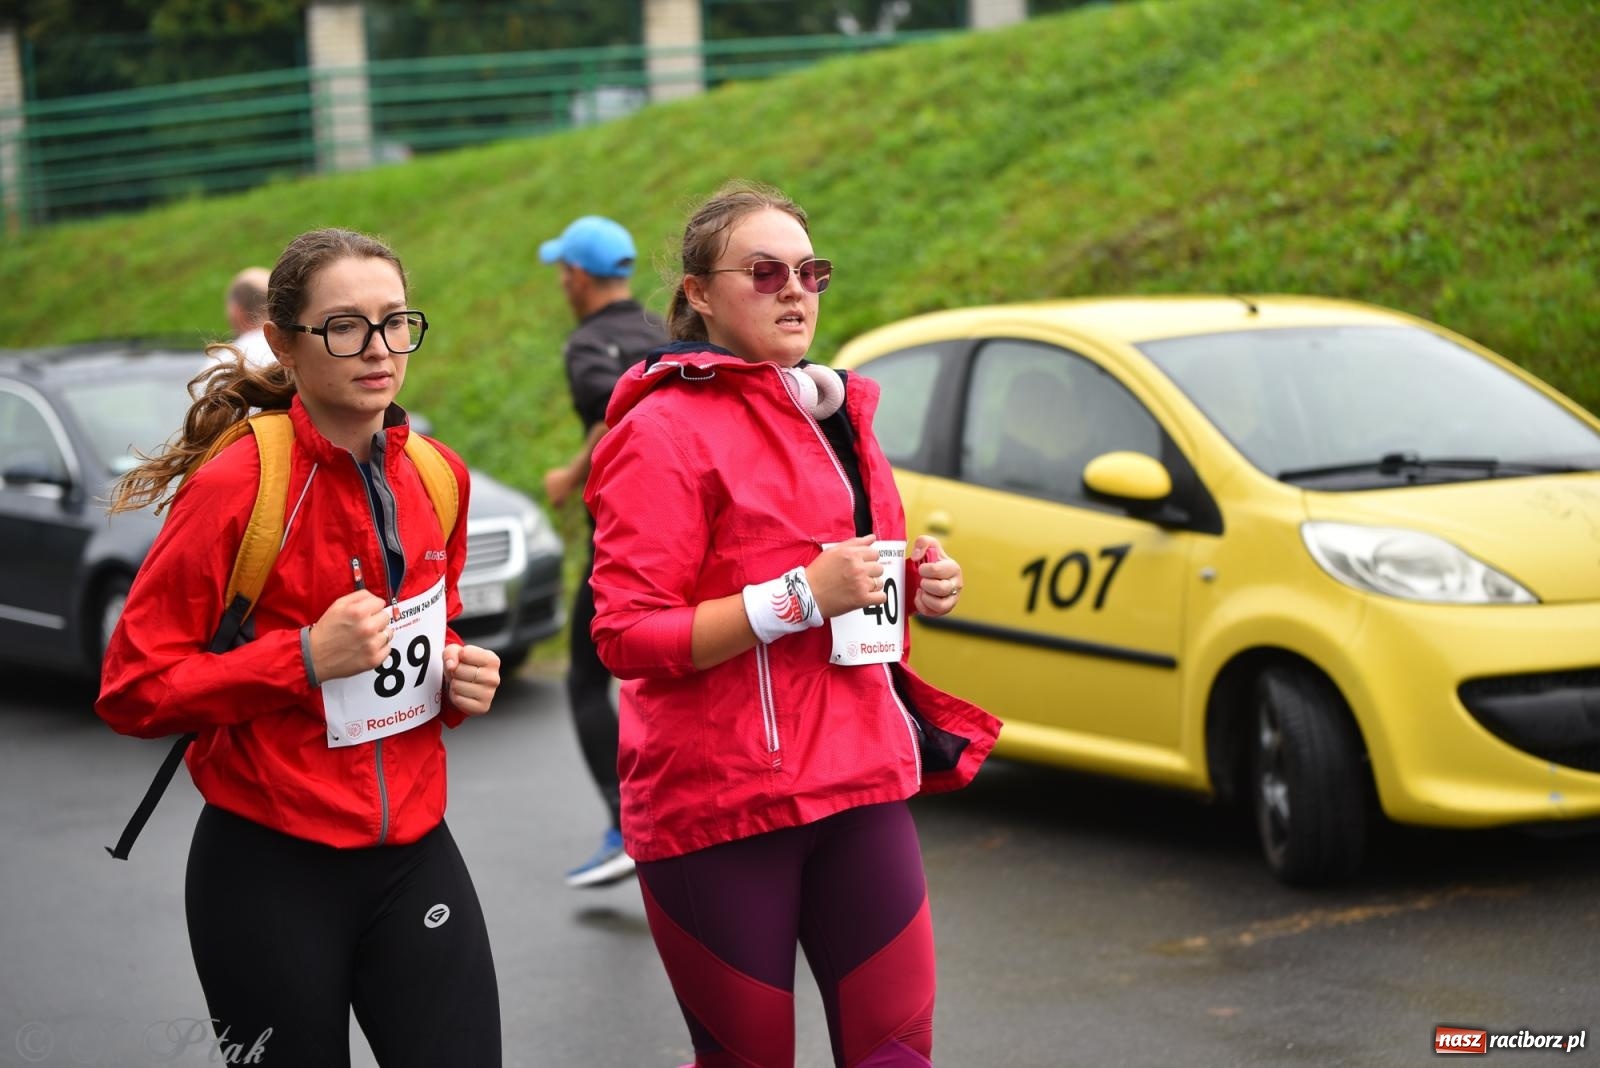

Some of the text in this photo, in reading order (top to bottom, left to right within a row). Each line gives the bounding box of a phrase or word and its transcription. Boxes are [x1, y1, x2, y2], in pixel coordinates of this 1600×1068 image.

[1020, 543, 1133, 613] 107
[374, 635, 431, 698] 89
[860, 641, 896, 654] Racibórz
[366, 703, 426, 731] Racibórz
